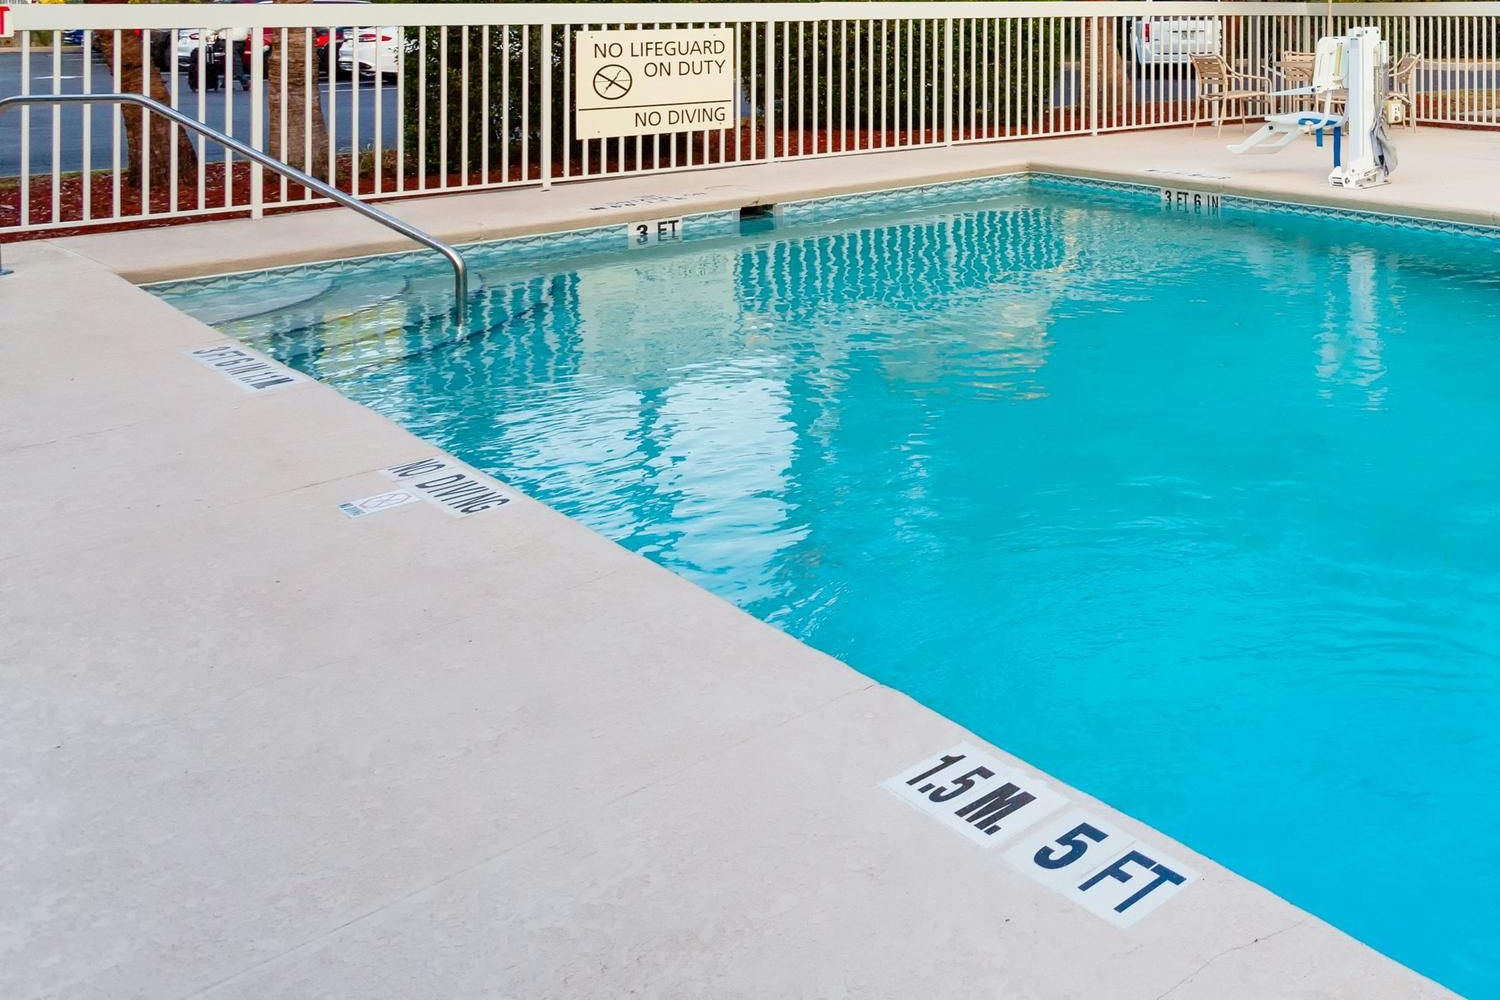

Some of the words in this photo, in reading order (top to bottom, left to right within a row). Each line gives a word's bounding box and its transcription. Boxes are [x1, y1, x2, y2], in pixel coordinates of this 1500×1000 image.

[594, 42, 623, 59] NO
[630, 40, 725, 57] LIFEGUARD
[643, 62, 671, 77] ON
[678, 60, 726, 76] DUTY
[635, 111, 662, 127] NO
[668, 107, 726, 125] DIVING
[1207, 195, 1219, 208] IN
[192, 346, 231, 354] 3
[214, 357, 255, 367] 6
[387, 458, 447, 477] NO
[415, 473, 511, 513] DIVING
[905, 754, 996, 803] 1.5
[953, 782, 1037, 836] M.
[1033, 822, 1109, 870] 5
[1077, 850, 1187, 914] FT
